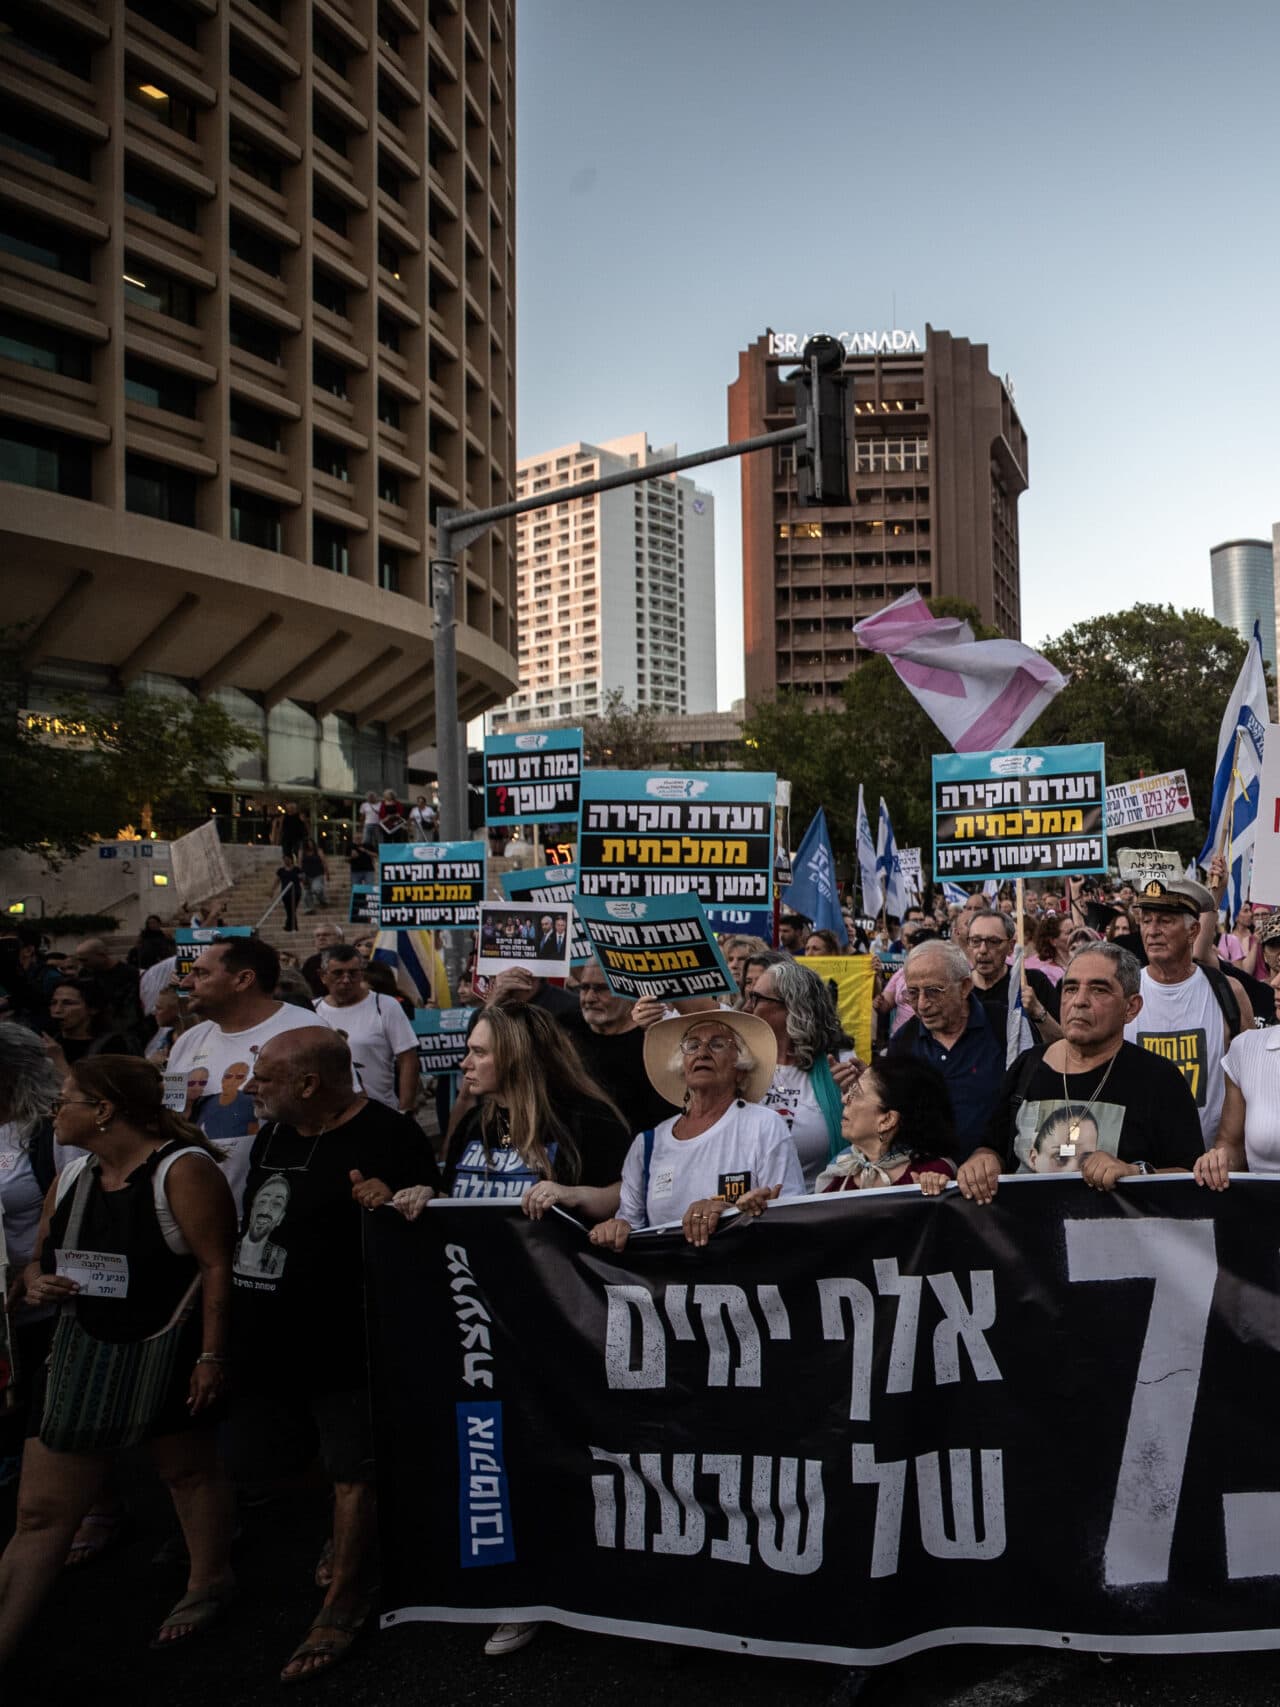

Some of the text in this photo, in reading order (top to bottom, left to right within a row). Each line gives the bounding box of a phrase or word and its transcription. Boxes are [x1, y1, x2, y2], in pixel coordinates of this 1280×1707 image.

[769, 330, 919, 354] ISRA CANADA
[488, 753, 579, 781] כמה דם עוד
[941, 775, 1096, 808] ועדת חקירה
[588, 804, 764, 832] ועדת חקירה
[954, 808, 1083, 839] ממלכתית
[601, 837, 748, 865] ממלכתית
[938, 846, 989, 870] ילדינו
[994, 843, 1052, 871] ביטחון
[1055, 840, 1101, 865] למען
[384, 863, 480, 881] ועדת חקירה
[582, 872, 640, 894] ילדינו
[392, 883, 472, 902] ממלכתית
[645, 873, 707, 896] ביטחון
[716, 872, 766, 901] למען
[381, 906, 414, 922] ילדינו
[415, 907, 453, 925] ביטחון
[588, 922, 640, 946] חקירה
[639, 921, 702, 945] ועדת
[605, 949, 700, 972] ממלכתית
[684, 971, 727, 993] למען
[724, 1181, 745, 1196] 101
[604, 1257, 1003, 1421] אלף ימים
[444, 1242, 506, 1557] מועצת אוקטובר
[588, 1442, 1007, 1579] של שבעה
